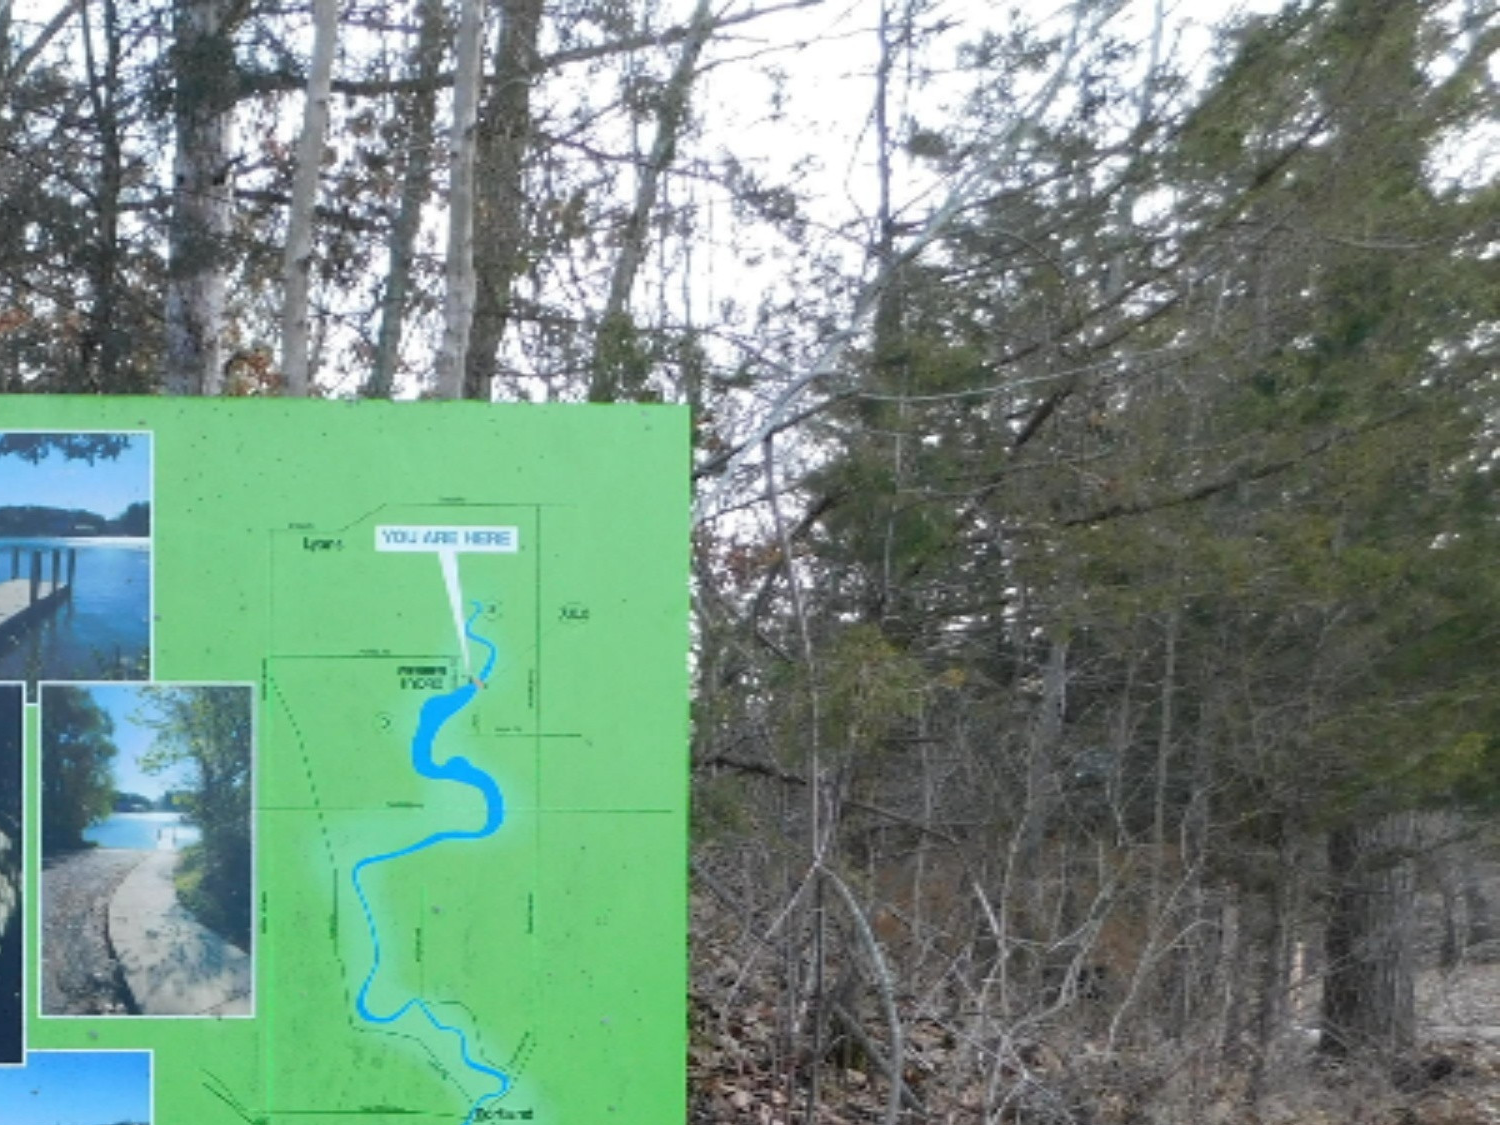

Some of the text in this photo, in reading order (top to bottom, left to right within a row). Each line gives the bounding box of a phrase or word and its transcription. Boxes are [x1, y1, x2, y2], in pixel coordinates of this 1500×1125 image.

[381, 529, 511, 546] YOU ARE HERE
